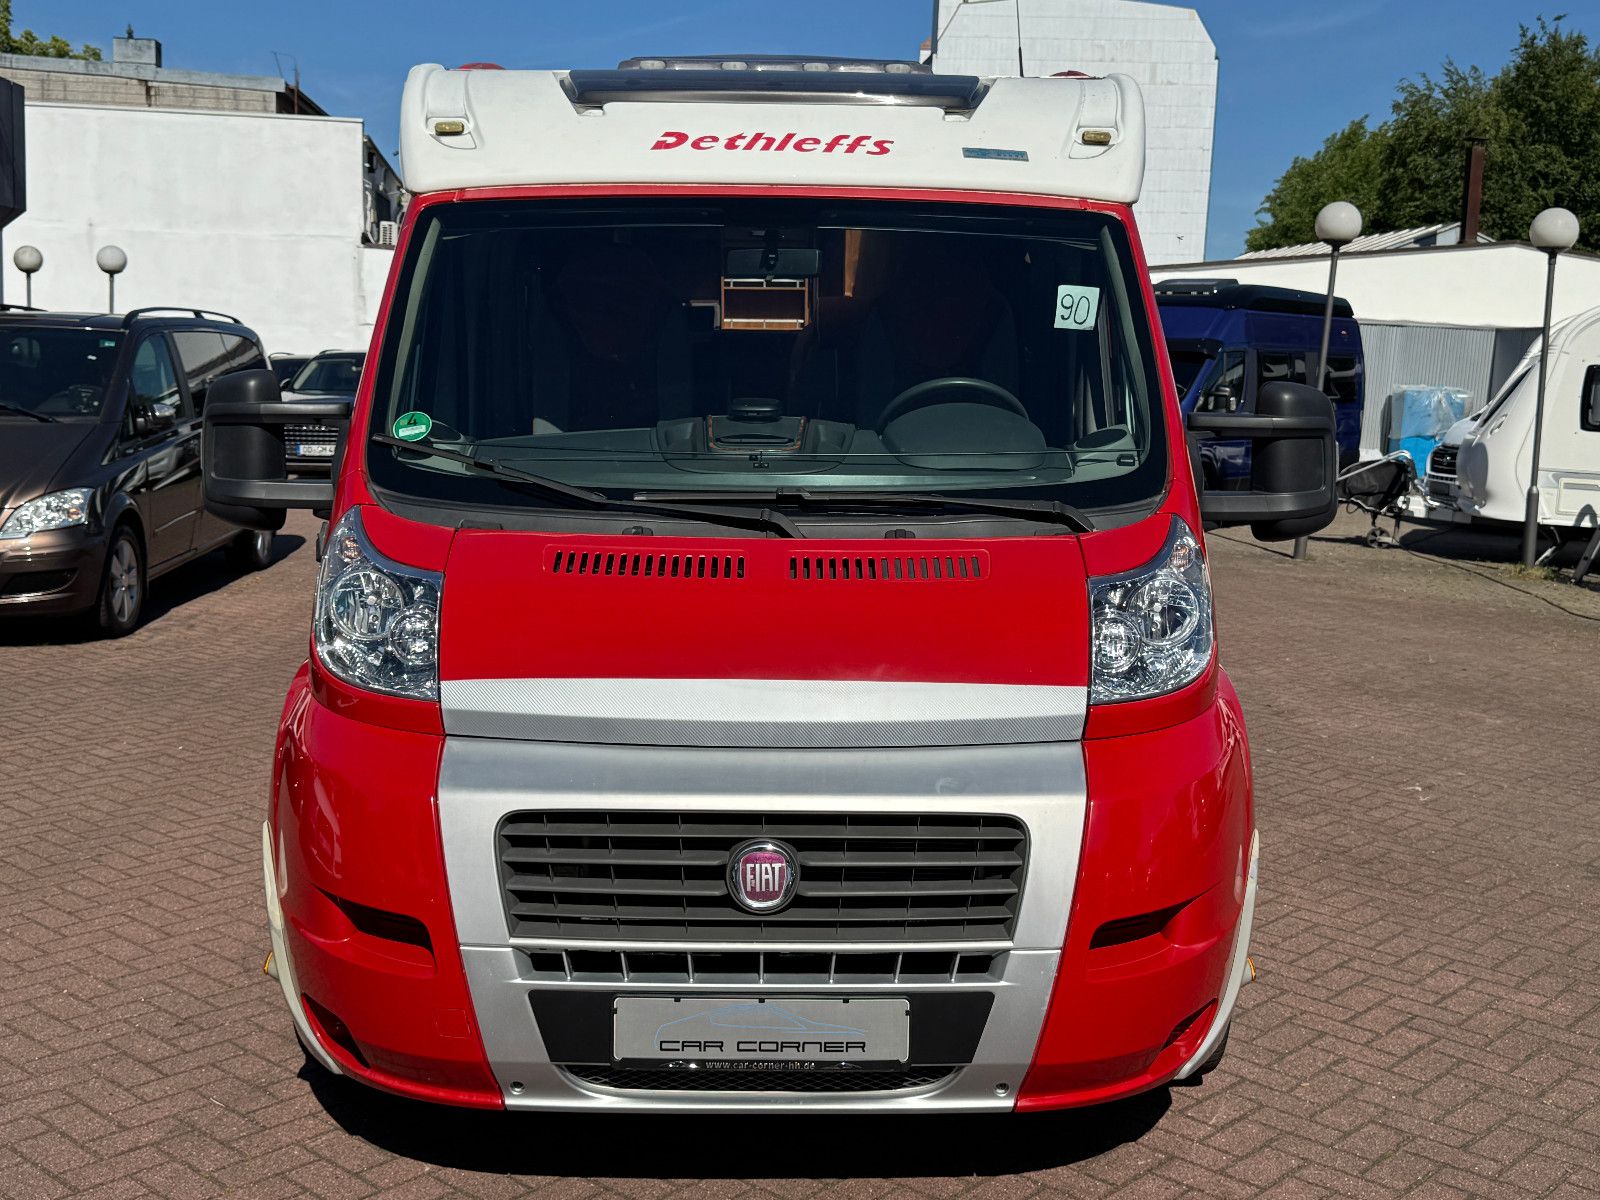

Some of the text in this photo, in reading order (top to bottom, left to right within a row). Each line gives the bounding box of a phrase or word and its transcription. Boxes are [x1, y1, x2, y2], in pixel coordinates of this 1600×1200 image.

[650, 131, 895, 156] Dethleffs
[1060, 293, 1091, 326] 90
[407, 413, 418, 426] 4
[745, 863, 782, 893] FIAT
[659, 1040, 866, 1053] CAR CORNER
[705, 1061, 816, 1070] www.car-corner-hh.de
